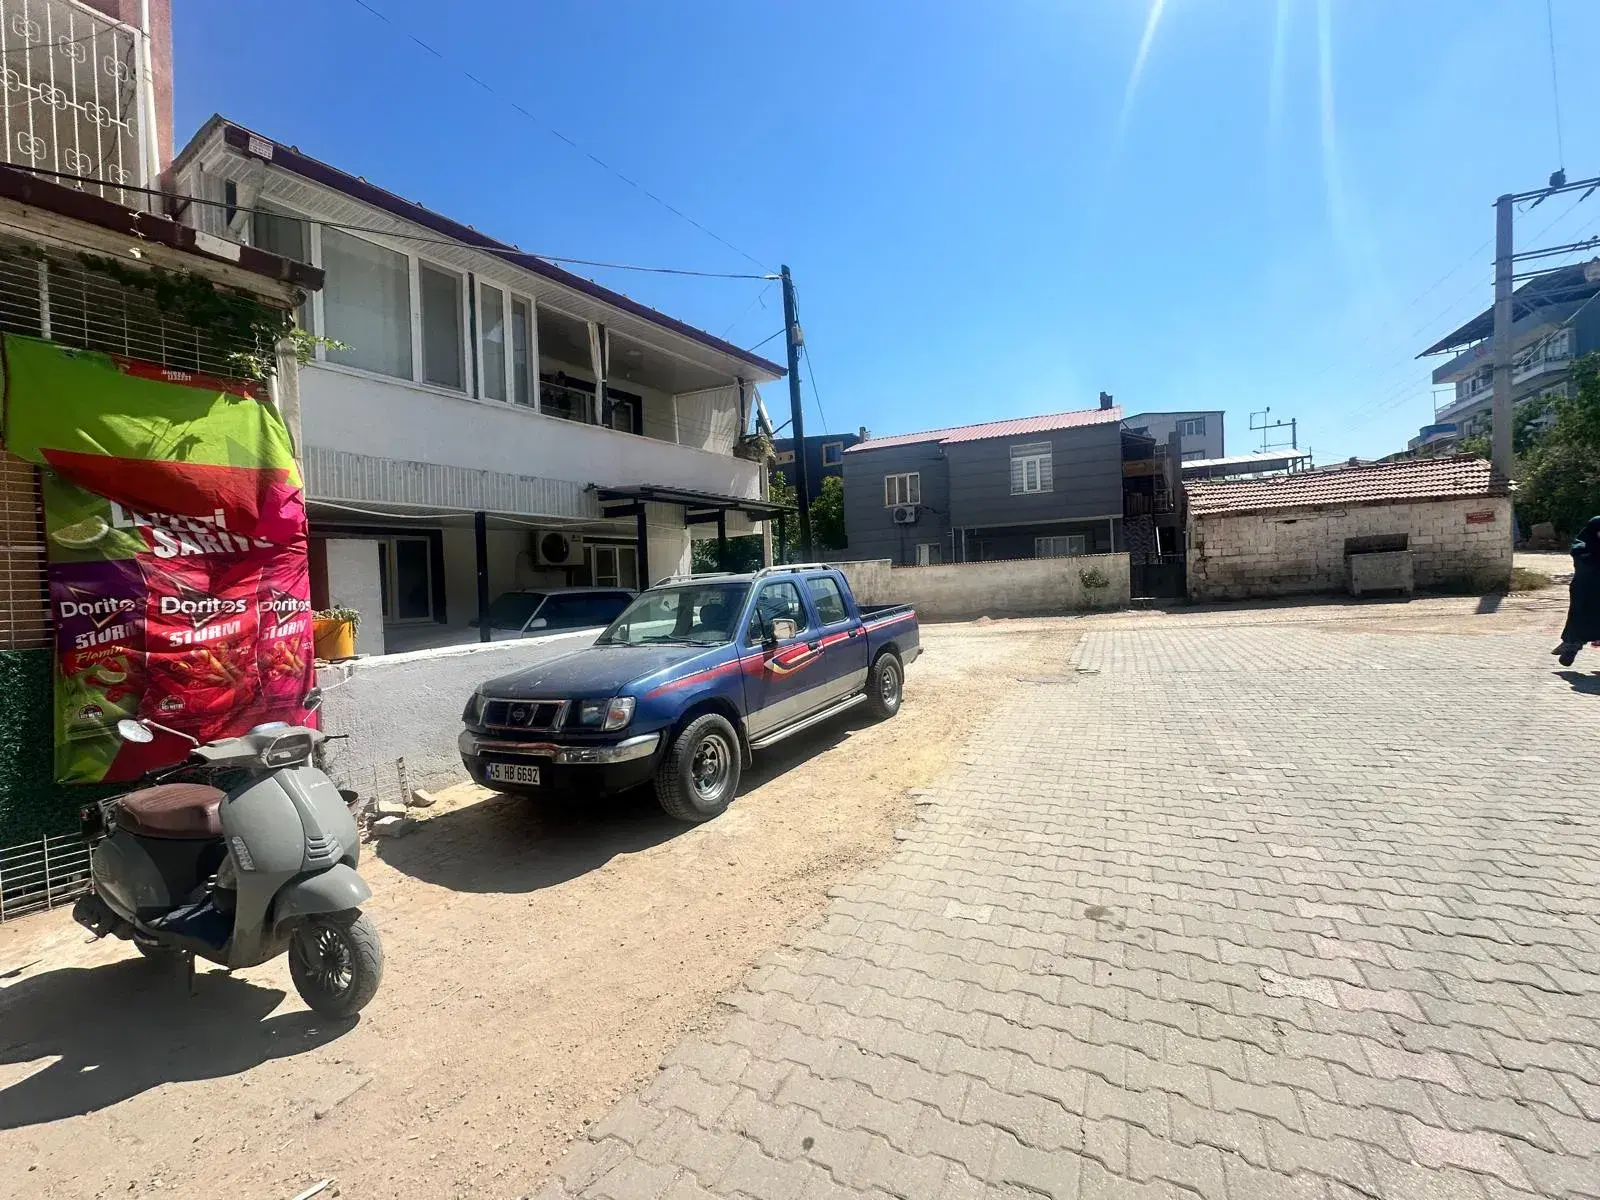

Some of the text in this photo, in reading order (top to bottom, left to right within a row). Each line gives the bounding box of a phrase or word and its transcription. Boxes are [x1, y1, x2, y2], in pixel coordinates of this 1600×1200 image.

[161, 597, 247, 614] Doritos
[169, 620, 241, 648] STORM
[490, 764, 500, 779] 45
[504, 765, 515, 780] HB
